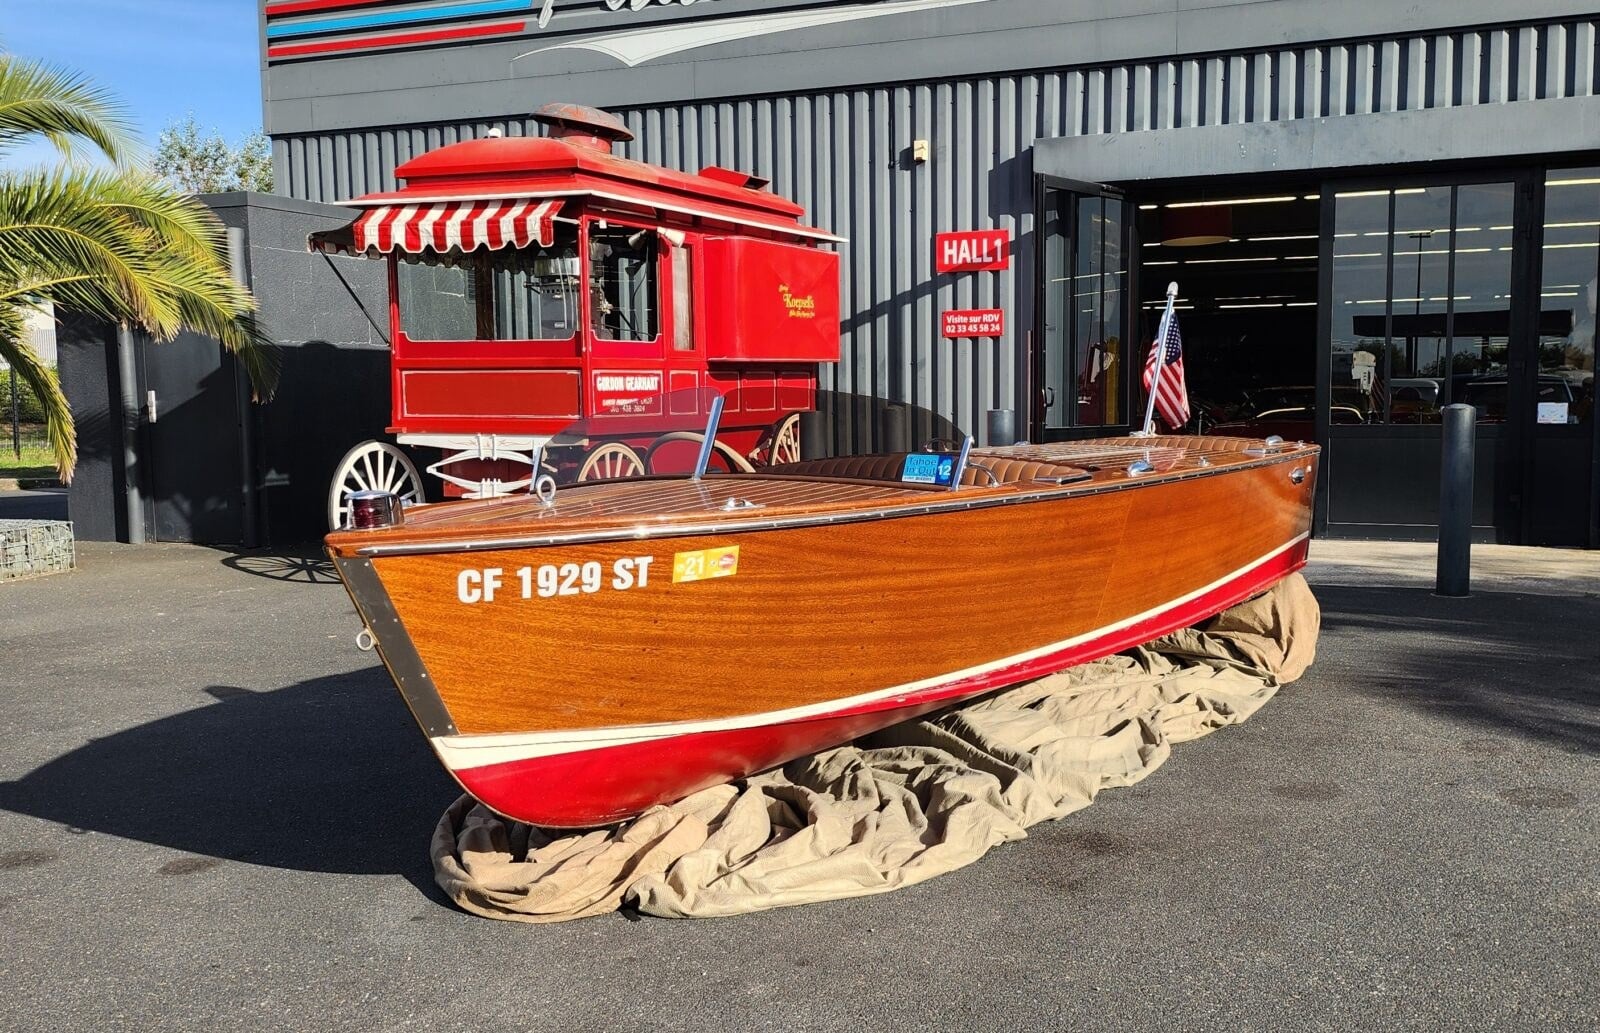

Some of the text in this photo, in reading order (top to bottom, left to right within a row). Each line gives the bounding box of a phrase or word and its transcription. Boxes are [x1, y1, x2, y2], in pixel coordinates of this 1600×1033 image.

[946, 315, 968, 323] Visite
[982, 313, 1000, 323] RDV
[979, 324, 989, 332] 58
[596, 376, 658, 391] GORDON GEARHART
[910, 456, 937, 466] Tahoe
[919, 466, 937, 475] Out
[938, 464, 952, 476] 12
[684, 556, 704, 577] 21
[457, 555, 654, 603] CF 1929 ST
